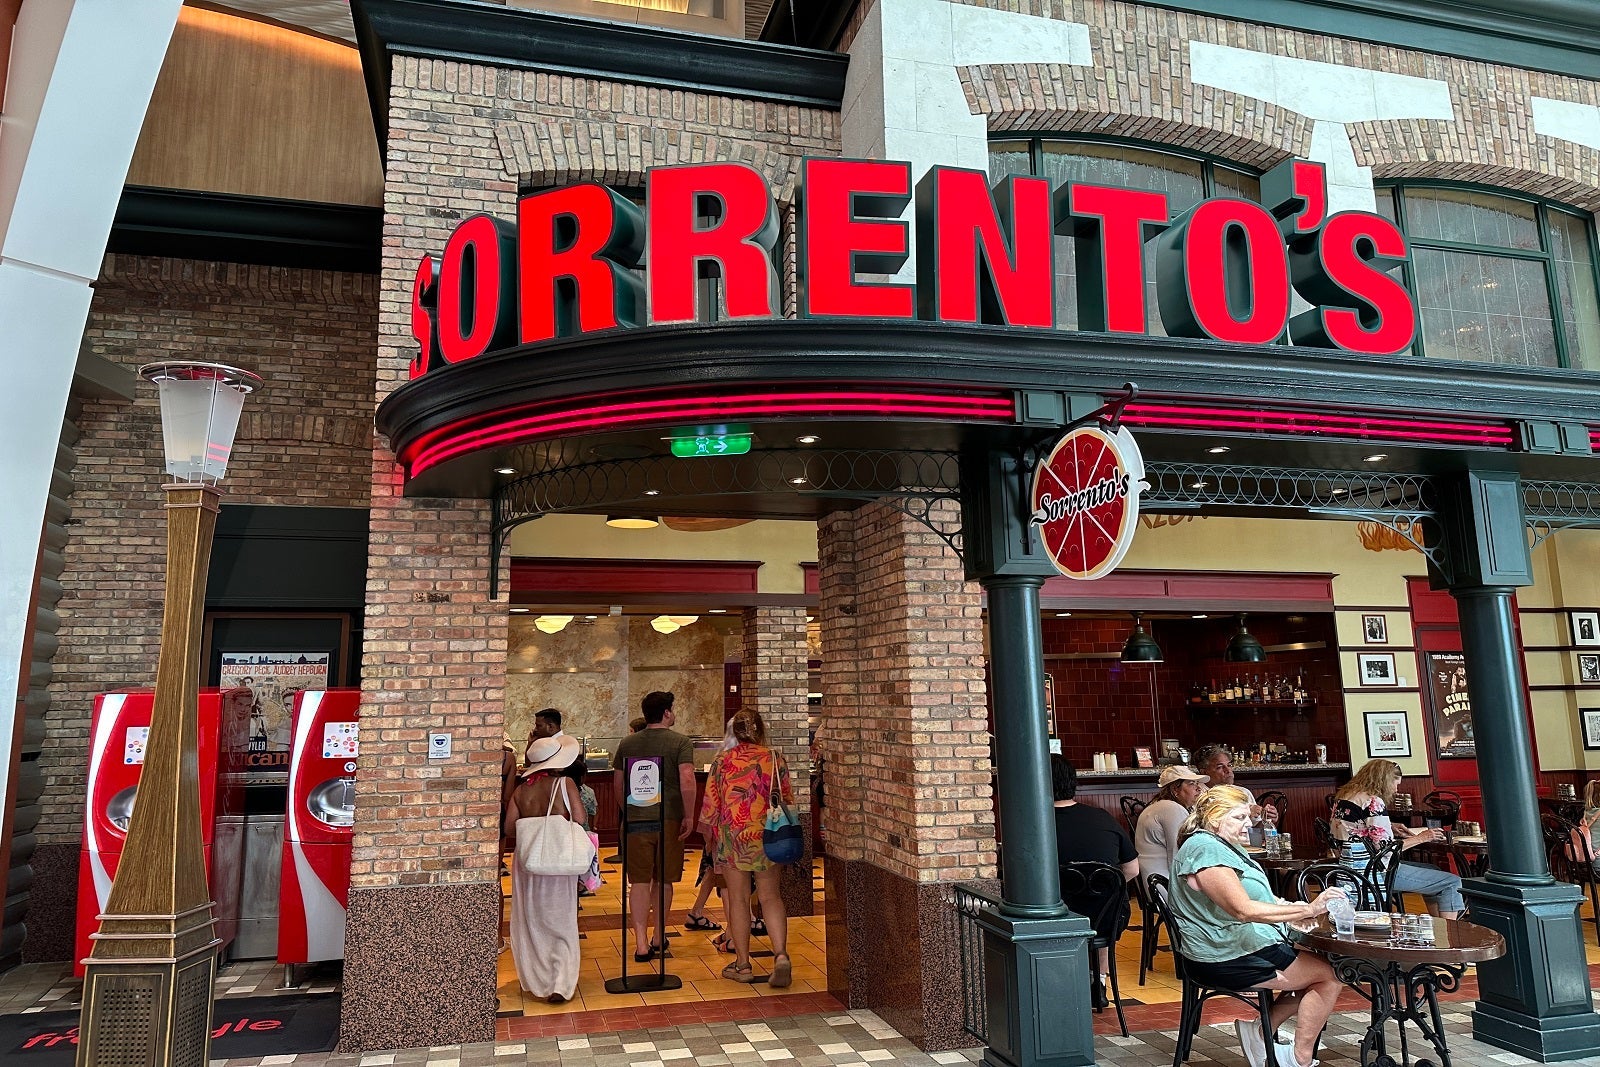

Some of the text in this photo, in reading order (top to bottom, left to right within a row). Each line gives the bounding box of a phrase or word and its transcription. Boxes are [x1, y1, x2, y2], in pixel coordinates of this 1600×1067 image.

[410, 158, 1416, 381] SORRENTO'S
[1030, 468, 1130, 526] Sorrento's
[222, 665, 327, 675] GREGORY PECK AUDREY HEPBURN
